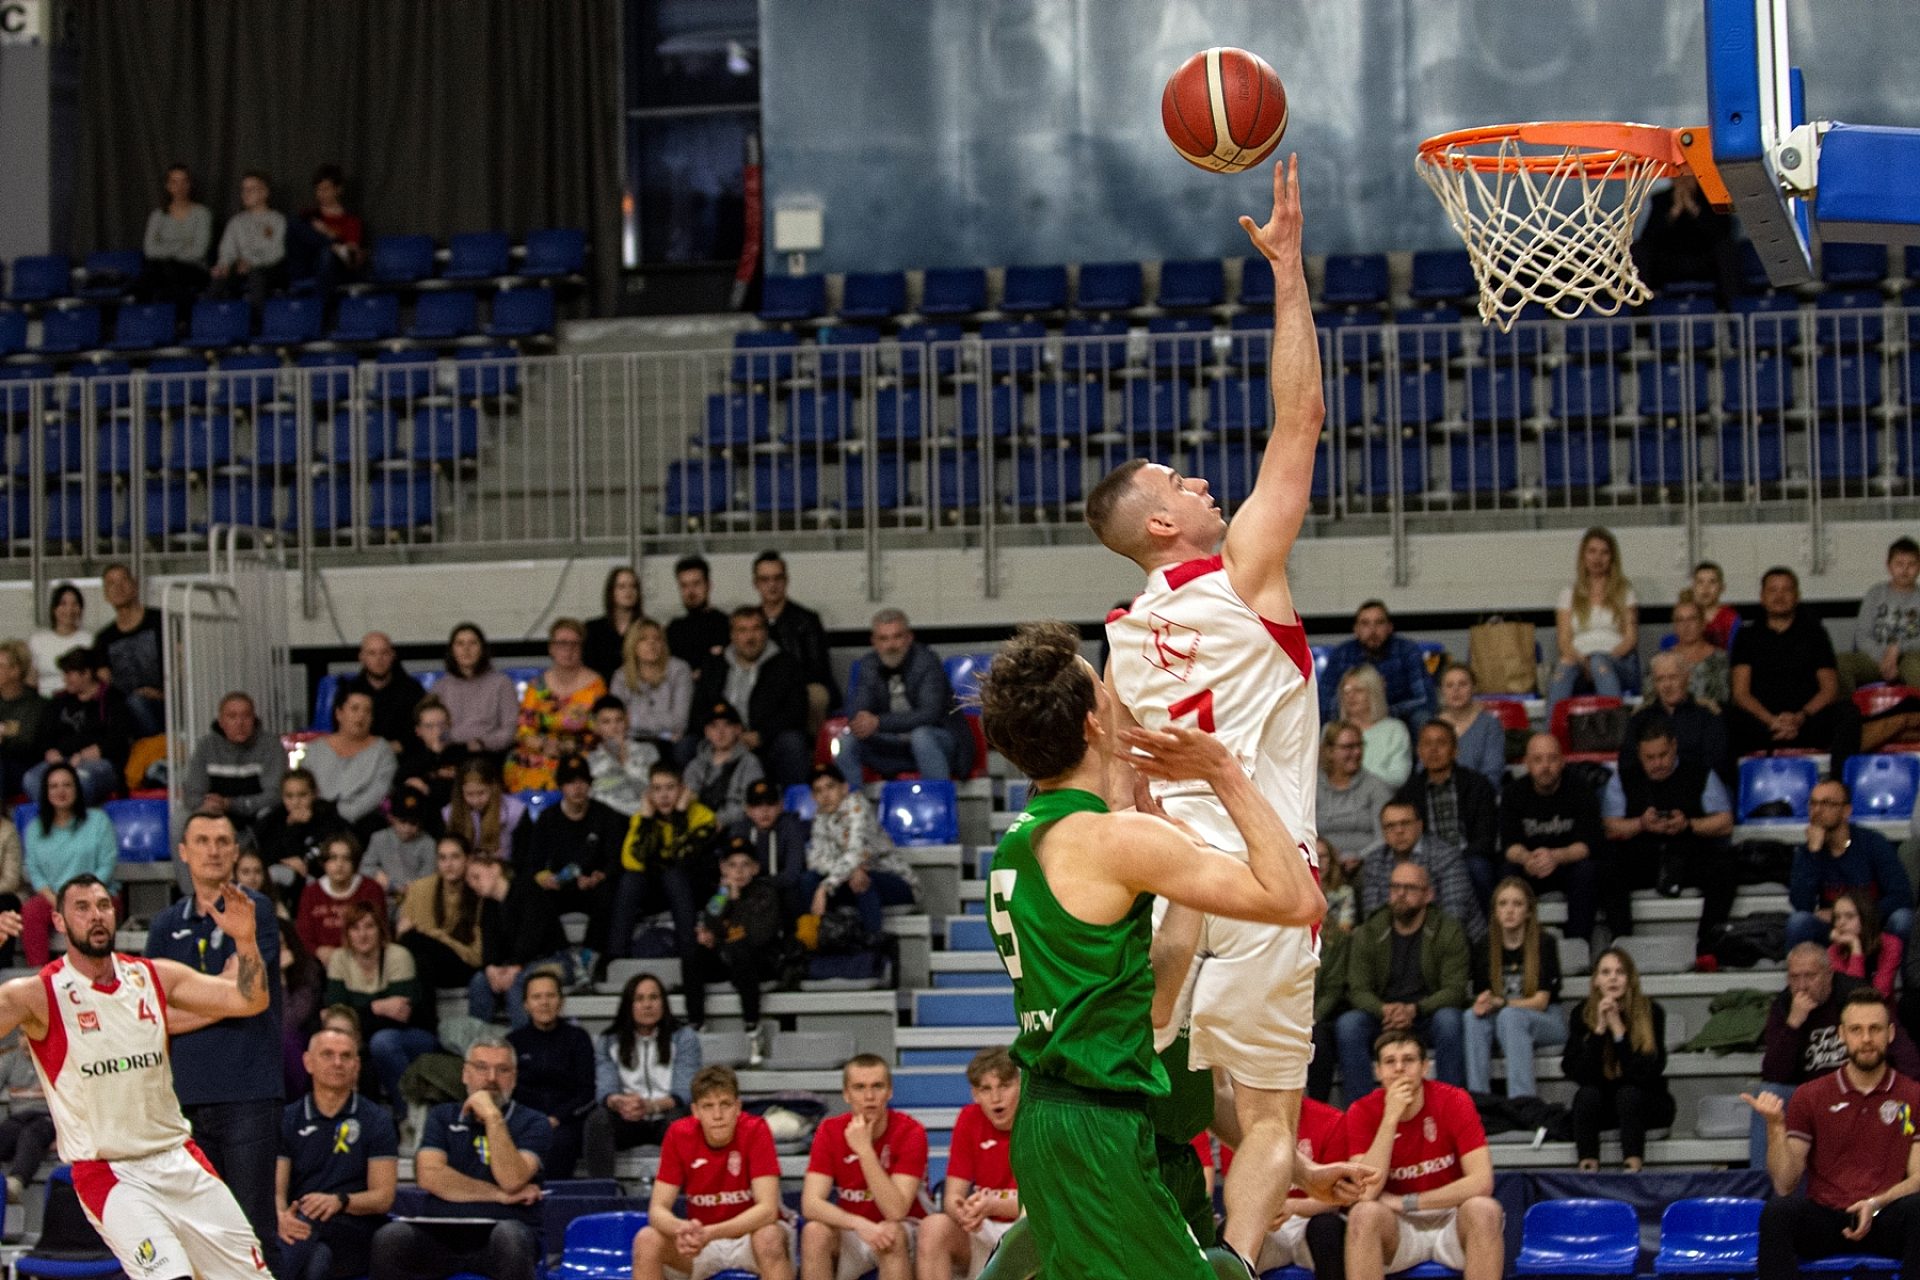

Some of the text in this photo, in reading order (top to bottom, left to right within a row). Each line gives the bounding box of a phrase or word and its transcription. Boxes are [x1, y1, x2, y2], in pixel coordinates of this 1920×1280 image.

[989, 869, 1024, 980] 5
[69, 990, 81, 1005] C
[138, 998, 158, 1025] 4
